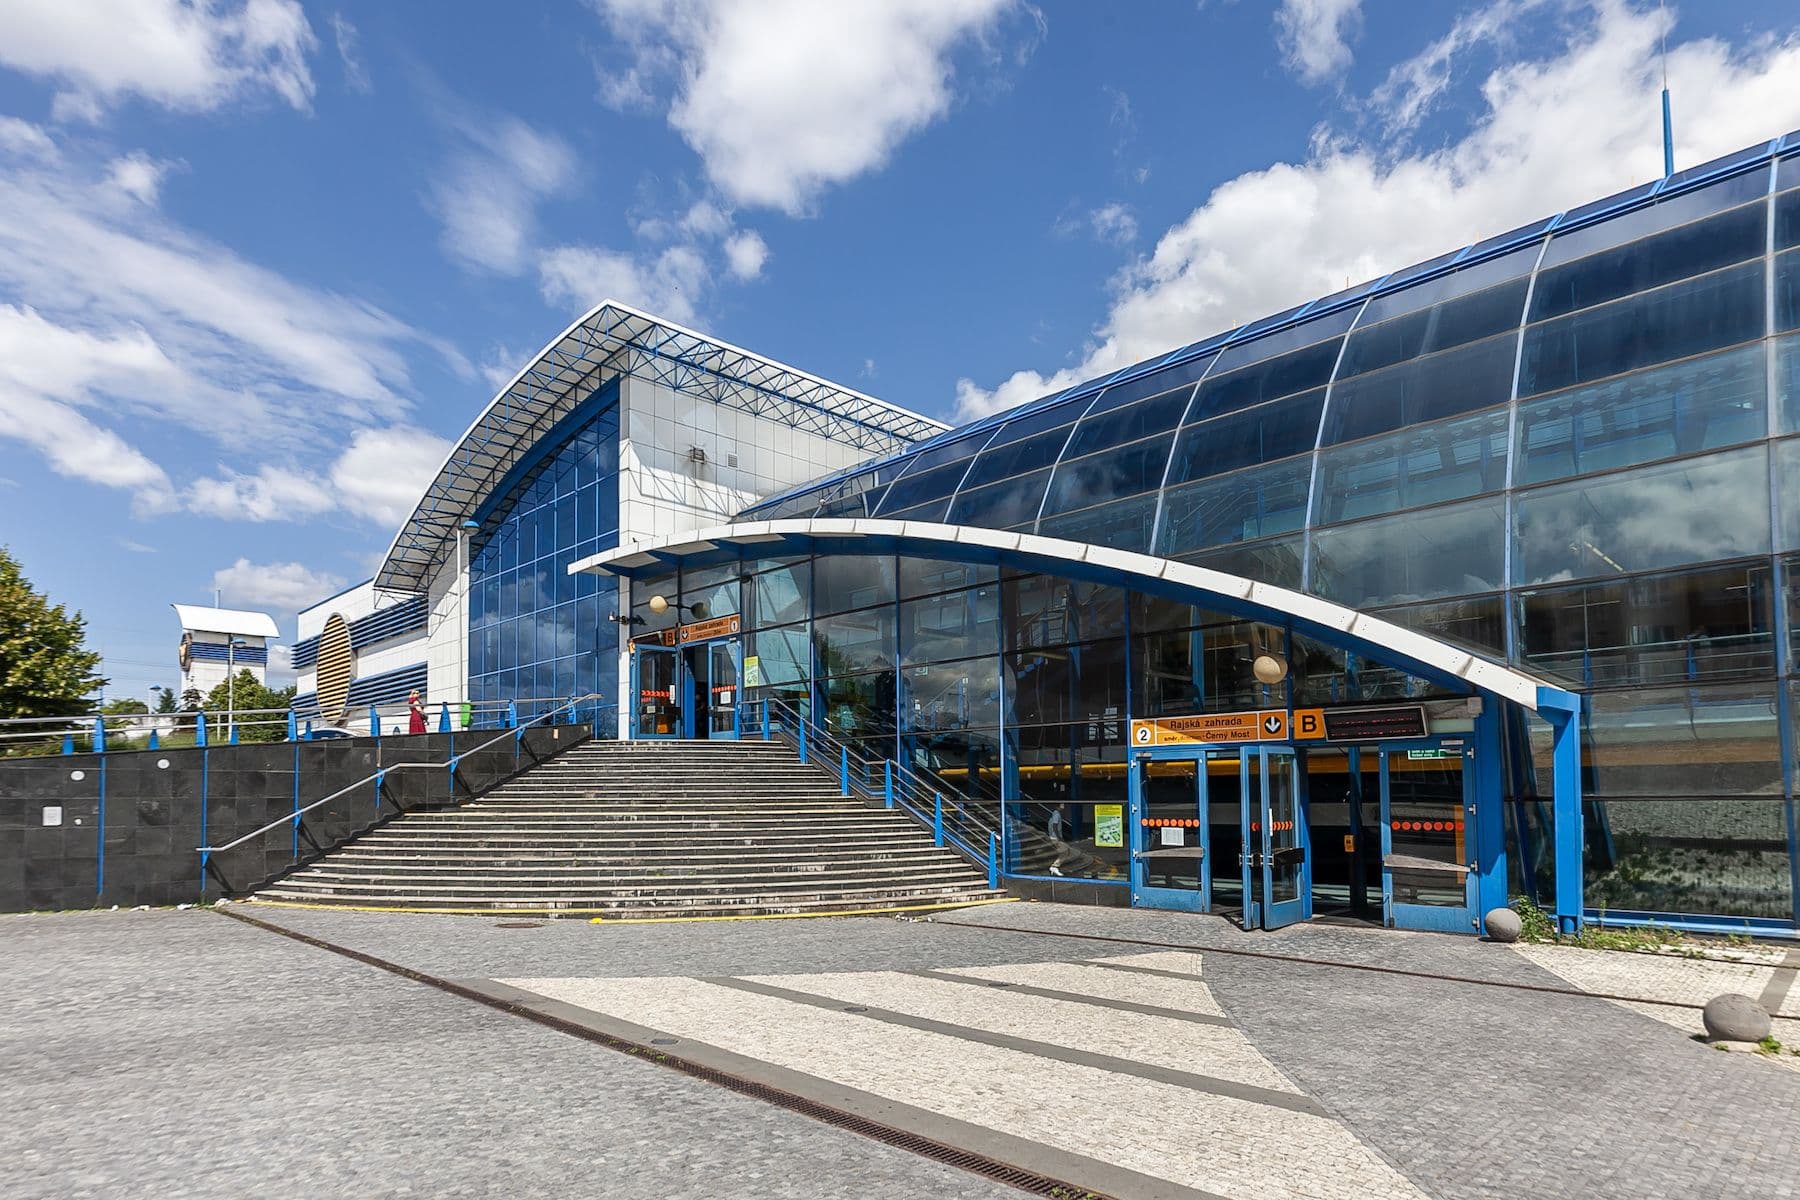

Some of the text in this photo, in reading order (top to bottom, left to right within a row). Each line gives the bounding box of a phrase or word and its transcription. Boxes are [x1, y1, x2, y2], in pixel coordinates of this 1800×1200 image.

[1170, 717, 1242, 730] Rajská zahrada
[1302, 715, 1317, 733] B
[1140, 729, 1148, 741] 2
